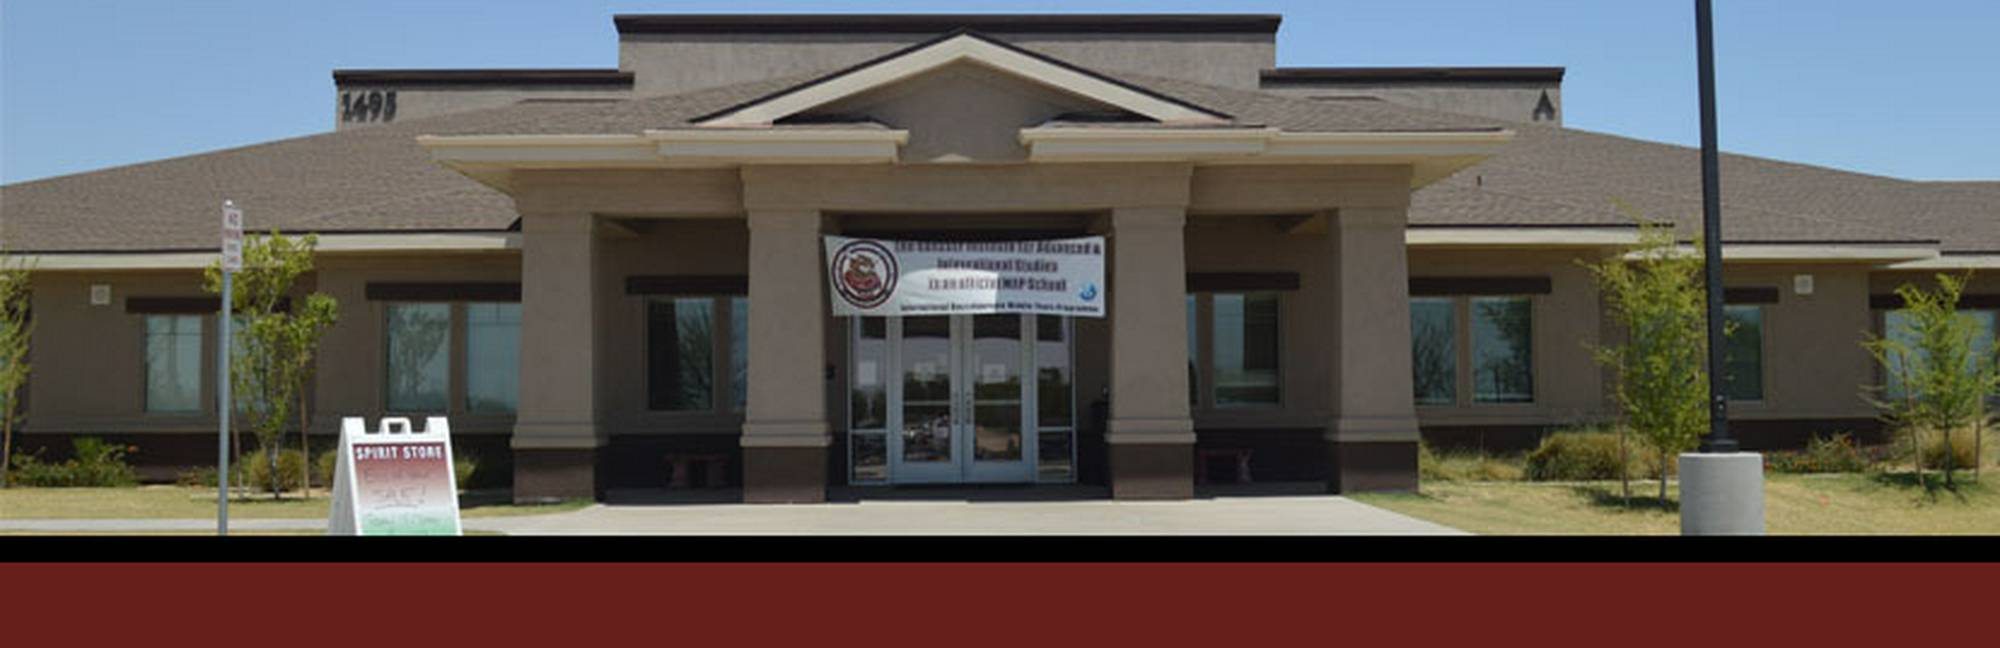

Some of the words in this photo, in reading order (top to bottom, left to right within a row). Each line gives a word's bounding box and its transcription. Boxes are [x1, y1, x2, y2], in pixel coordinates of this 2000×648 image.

[343, 91, 397, 123] 1495
[1532, 88, 1555, 122] A
[937, 258, 1013, 271] International
[1015, 259, 1058, 272] Studies
[1027, 277, 1066, 292] School
[356, 446, 398, 460] SPIRIT
[402, 446, 442, 460] STORE
